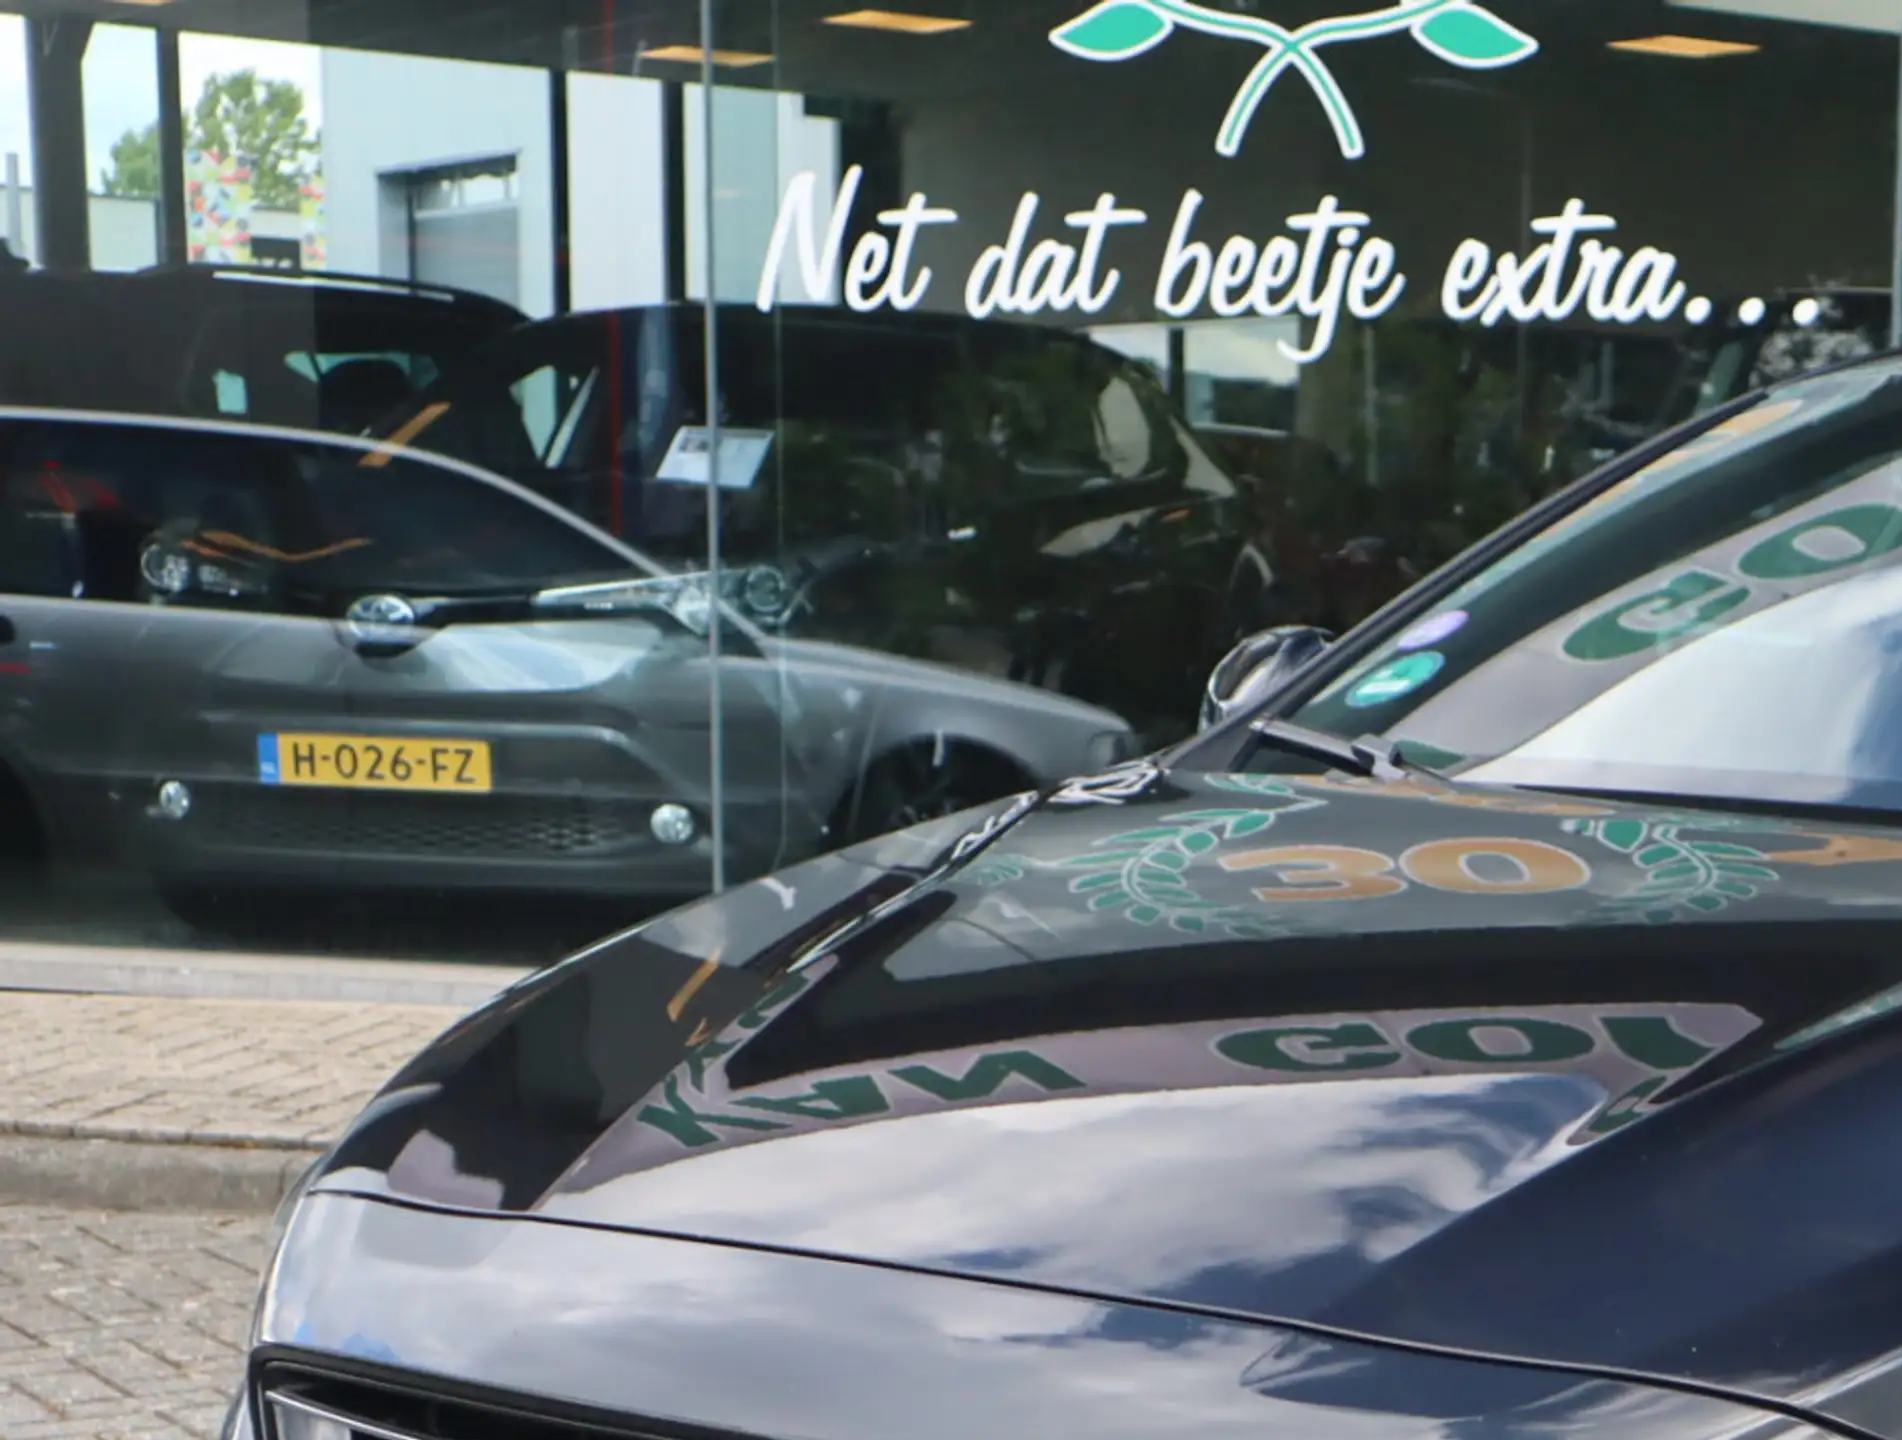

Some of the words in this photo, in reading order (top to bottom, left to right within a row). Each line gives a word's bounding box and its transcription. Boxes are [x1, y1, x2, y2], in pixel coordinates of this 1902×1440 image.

[757, 165, 957, 313] Net
[965, 192, 1146, 318] dat
[1153, 189, 1404, 364] beetje
[1441, 198, 1820, 327] extra...
[292, 742, 476, 784] H-026-FZ
